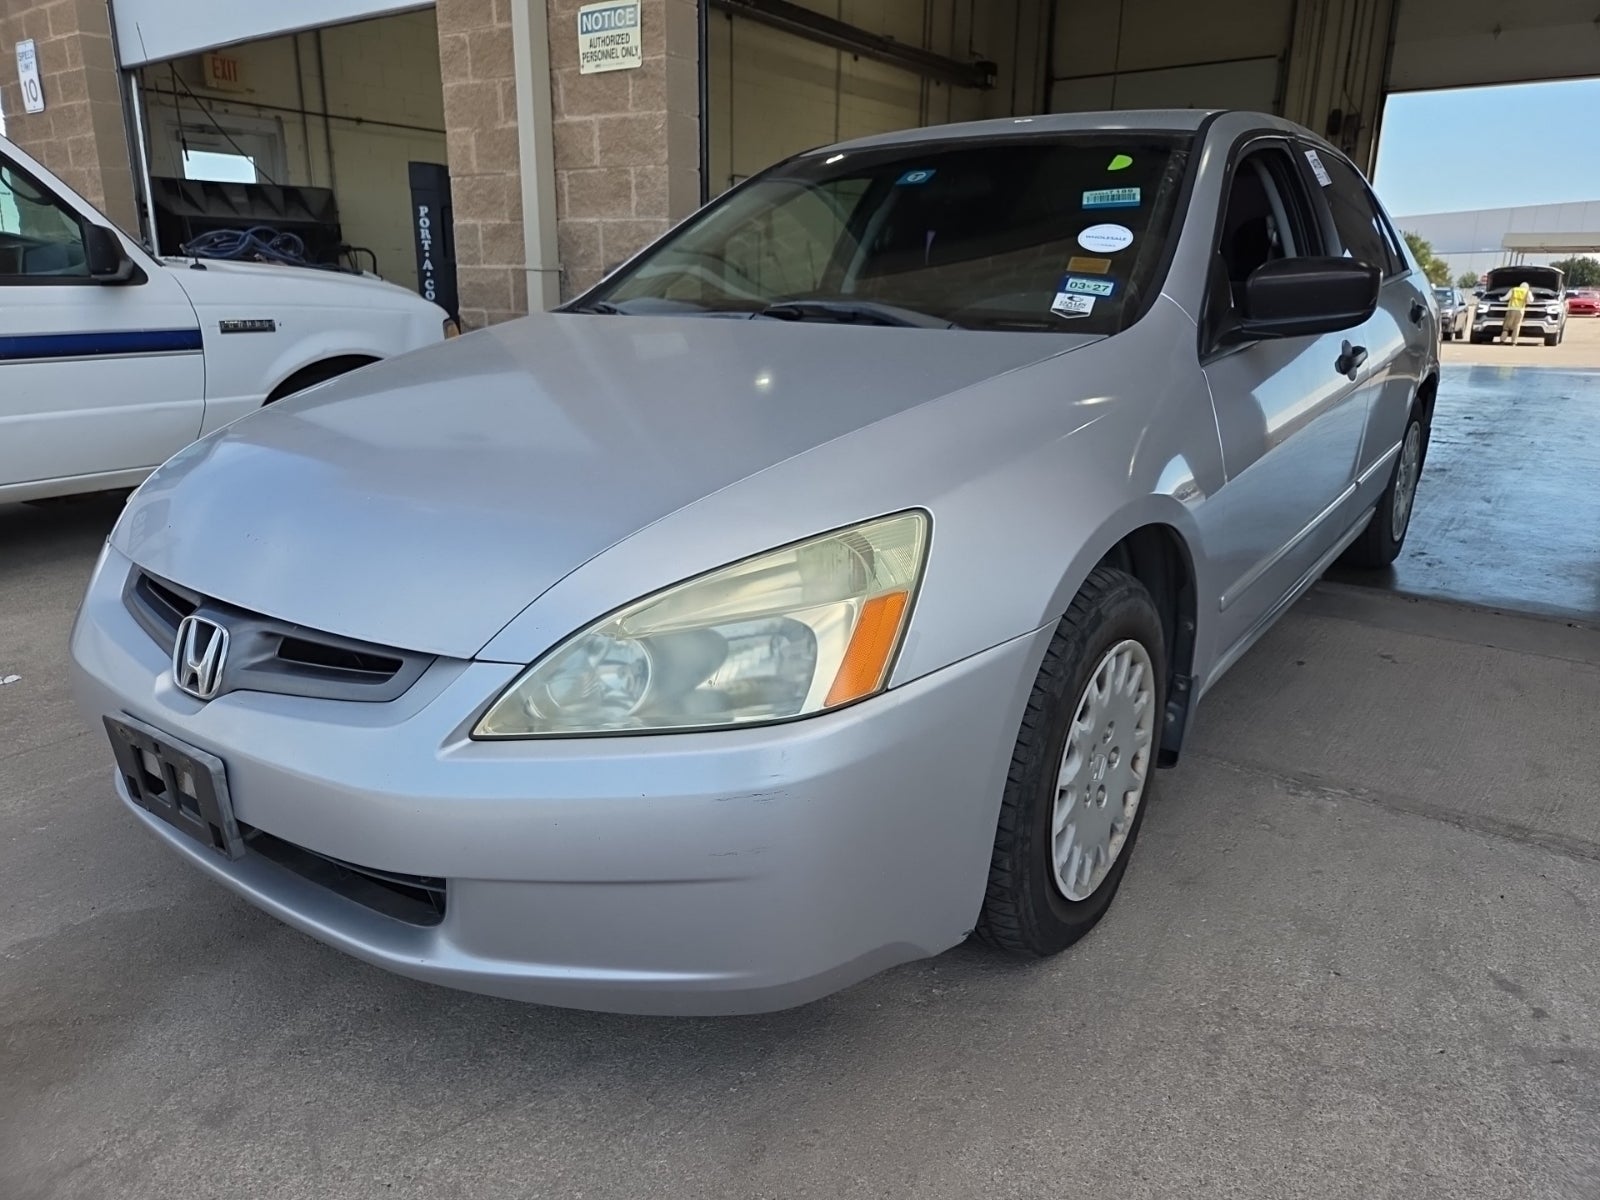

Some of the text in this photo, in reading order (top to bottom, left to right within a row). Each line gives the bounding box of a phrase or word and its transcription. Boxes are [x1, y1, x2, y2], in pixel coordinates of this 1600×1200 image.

[582, 7, 635, 32] NOTICE
[589, 33, 631, 49] AUTHORIZED
[582, 45, 639, 63] PERSONNEL ONLY
[212, 56, 238, 82] EXIT
[23, 78, 38, 103] 10
